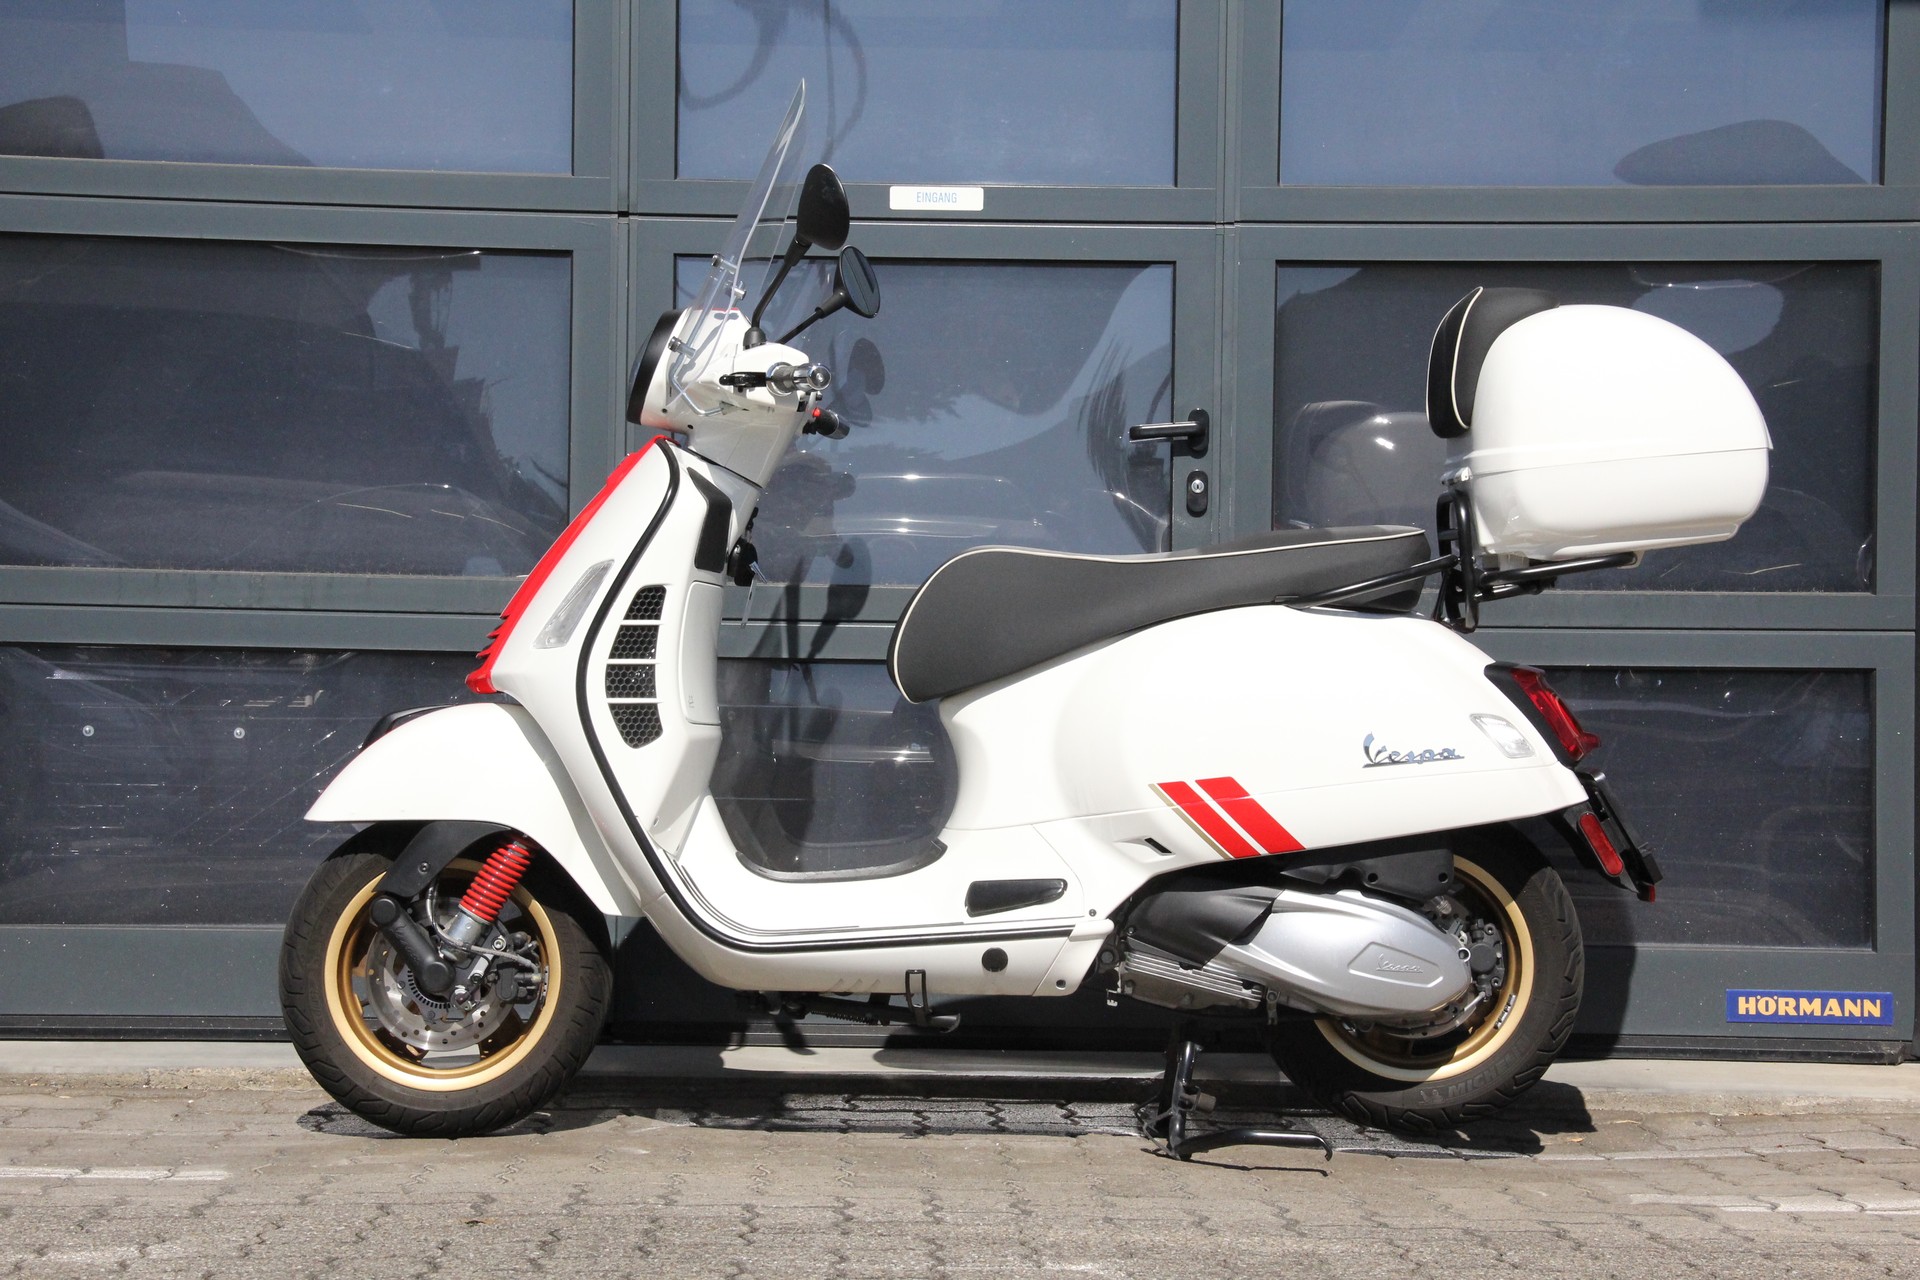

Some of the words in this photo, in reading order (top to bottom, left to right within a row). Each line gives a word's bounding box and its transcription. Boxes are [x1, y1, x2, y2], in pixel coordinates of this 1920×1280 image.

[916, 191, 957, 203] EINGANG
[1362, 731, 1465, 769] Vespa
[1738, 995, 1881, 1018] HÖRMANN
